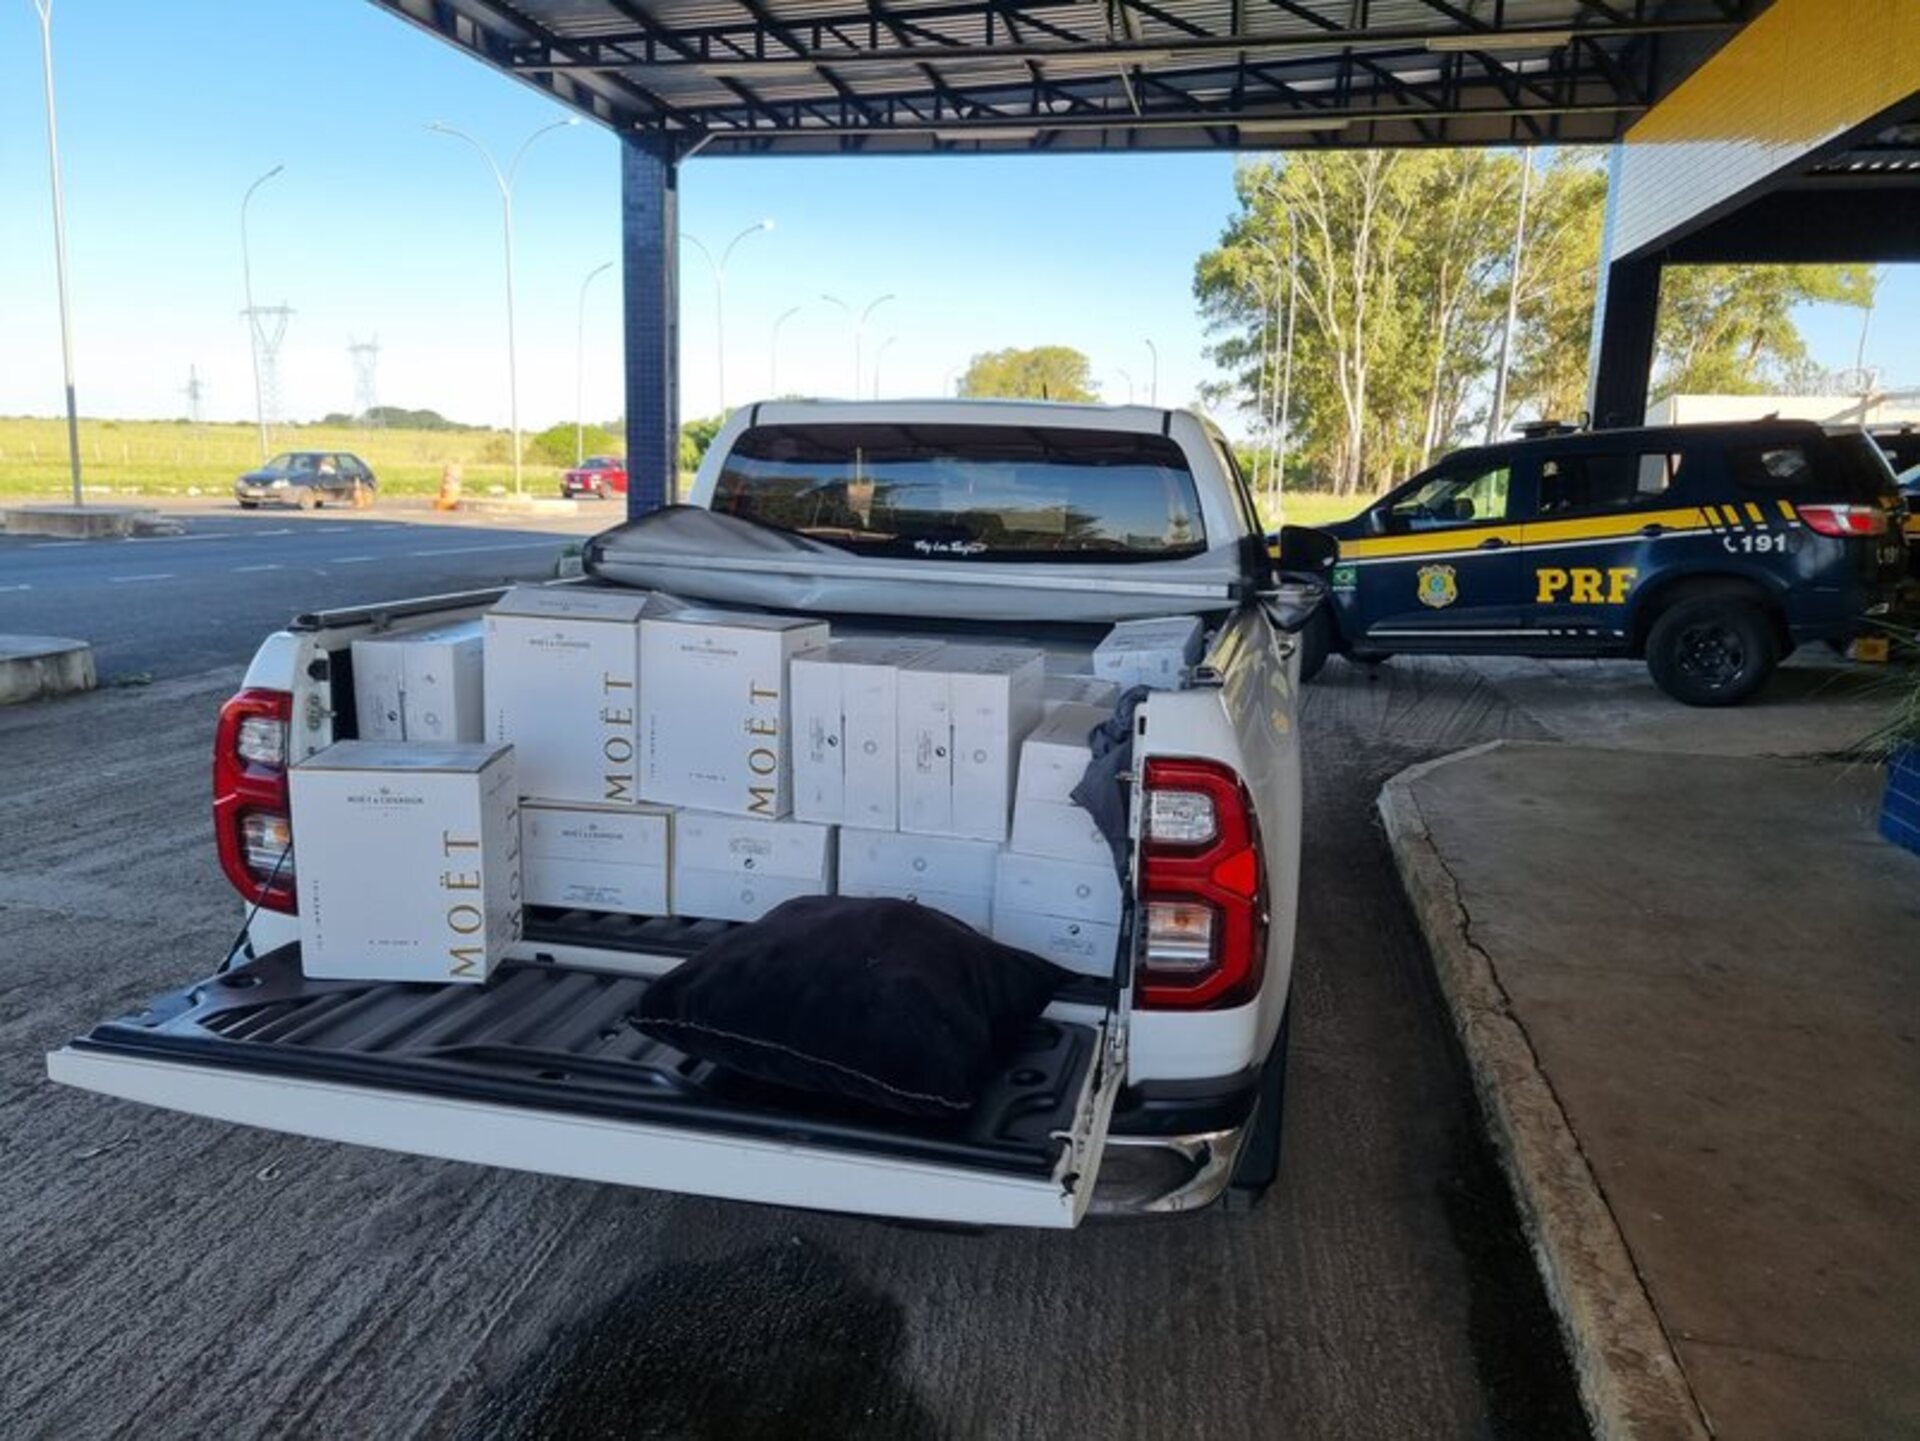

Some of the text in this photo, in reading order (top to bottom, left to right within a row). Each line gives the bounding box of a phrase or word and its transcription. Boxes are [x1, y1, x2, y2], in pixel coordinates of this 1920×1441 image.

[1535, 567, 1638, 604] PRF
[1741, 534, 1787, 552] 191
[600, 671, 633, 803] MOËT
[745, 679, 778, 817] MOËT
[439, 830, 484, 978] MOËT
